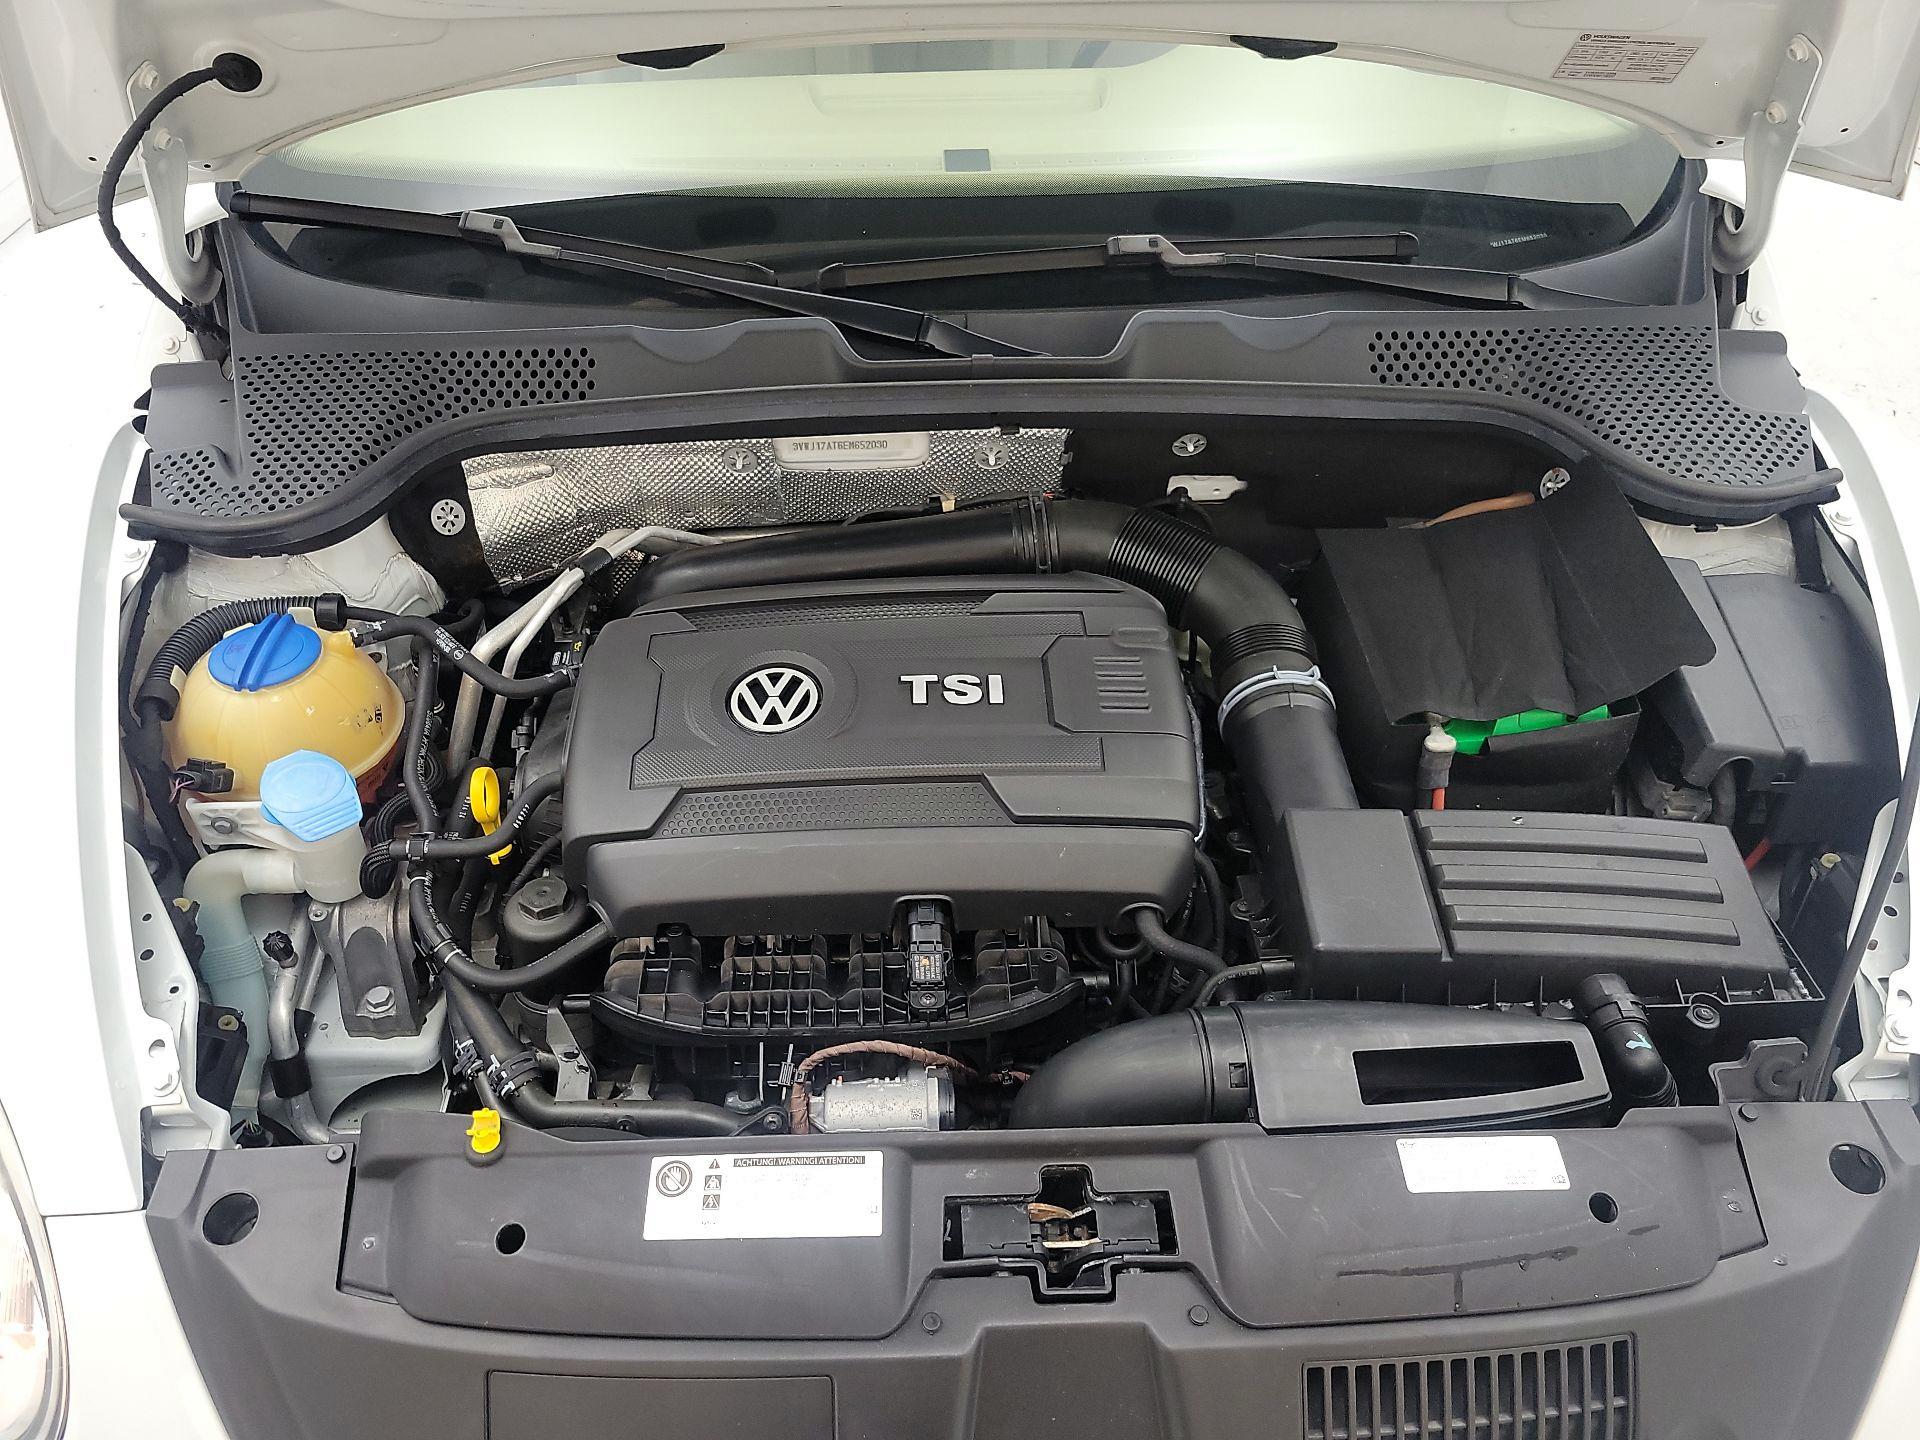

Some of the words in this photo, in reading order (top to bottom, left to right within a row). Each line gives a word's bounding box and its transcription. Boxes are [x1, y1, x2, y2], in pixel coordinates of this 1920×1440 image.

[792, 440, 888, 451] 3VWJ17AT6EM652030
[900, 674, 1004, 705] TSI
[736, 1157, 776, 1166] ACHTUNG!
[778, 1156, 818, 1165] WARNING!
[819, 1156, 863, 1165] ATTENTION!
